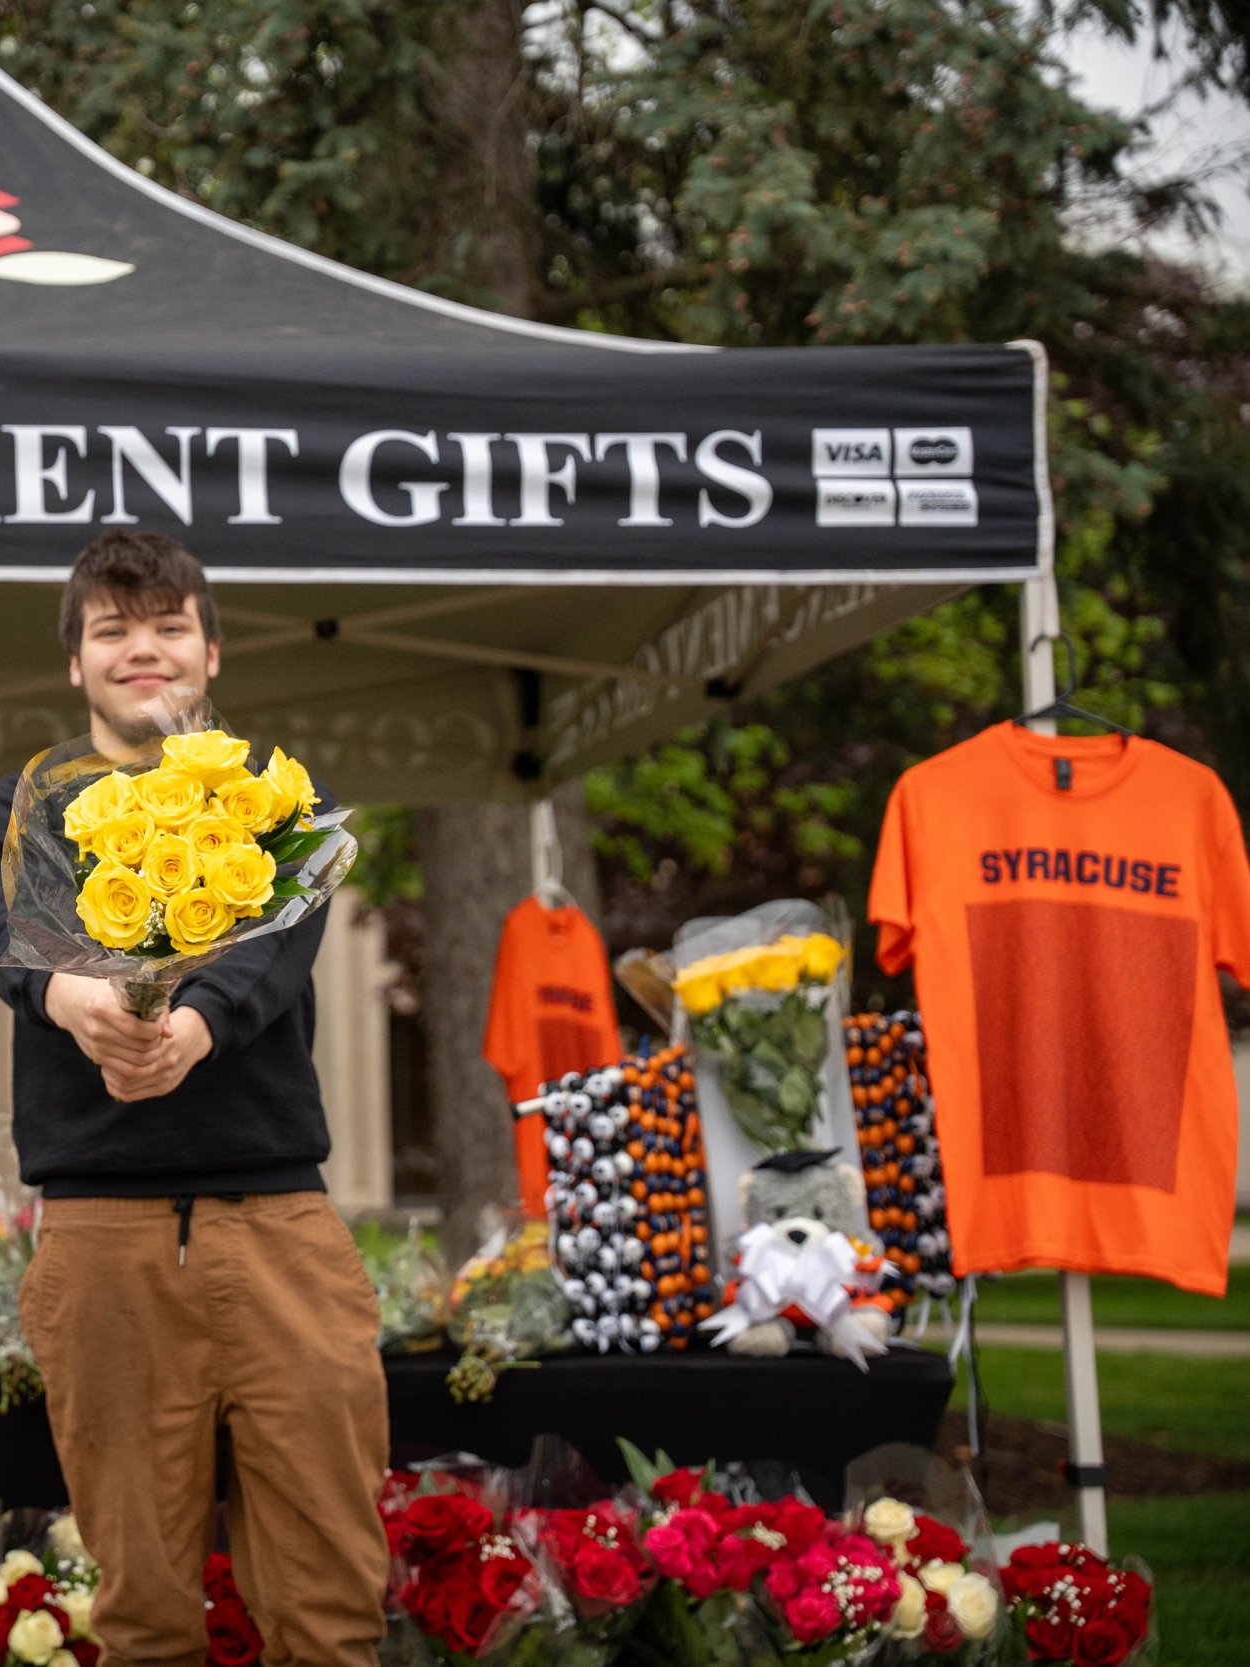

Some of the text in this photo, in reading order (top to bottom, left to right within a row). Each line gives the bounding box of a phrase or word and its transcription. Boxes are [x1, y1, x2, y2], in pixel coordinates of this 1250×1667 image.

[823, 442, 883, 462] VISA
[339, 429, 773, 528] GIFTS
[981, 848, 1181, 897] SYRACUSE
